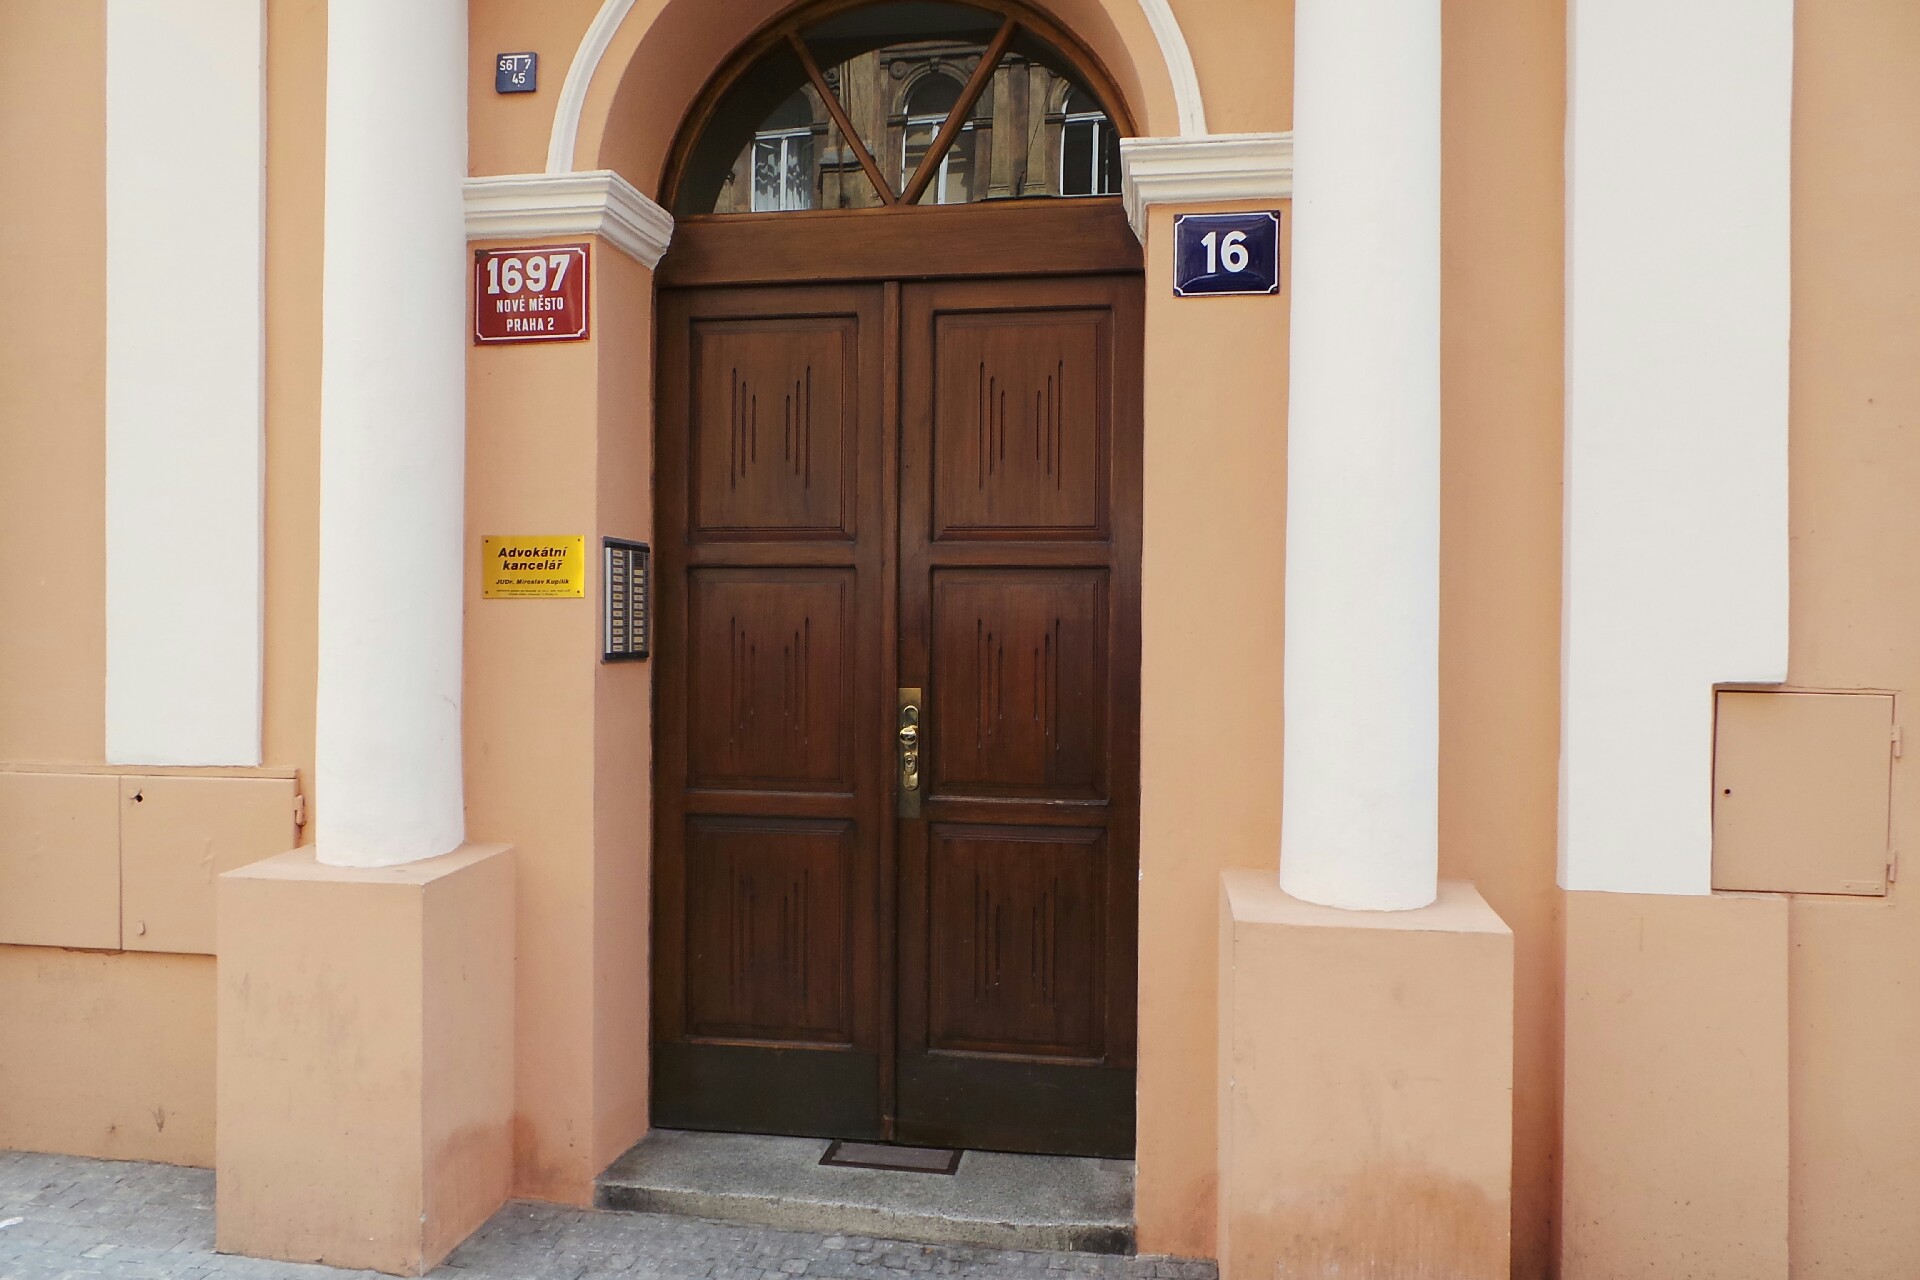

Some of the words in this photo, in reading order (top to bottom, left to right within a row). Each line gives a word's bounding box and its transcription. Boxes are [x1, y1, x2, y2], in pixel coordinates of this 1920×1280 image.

[512, 73, 526, 84] 45
[1200, 230, 1249, 274] 16
[487, 254, 570, 294] 1697
[496, 295, 525, 313] NOVÉ
[529, 294, 564, 312] MĚSTO
[506, 318, 544, 332] PRAHA
[547, 317, 554, 331] 2
[498, 546, 568, 558] Advokátní
[502, 559, 563, 571] kancelář
